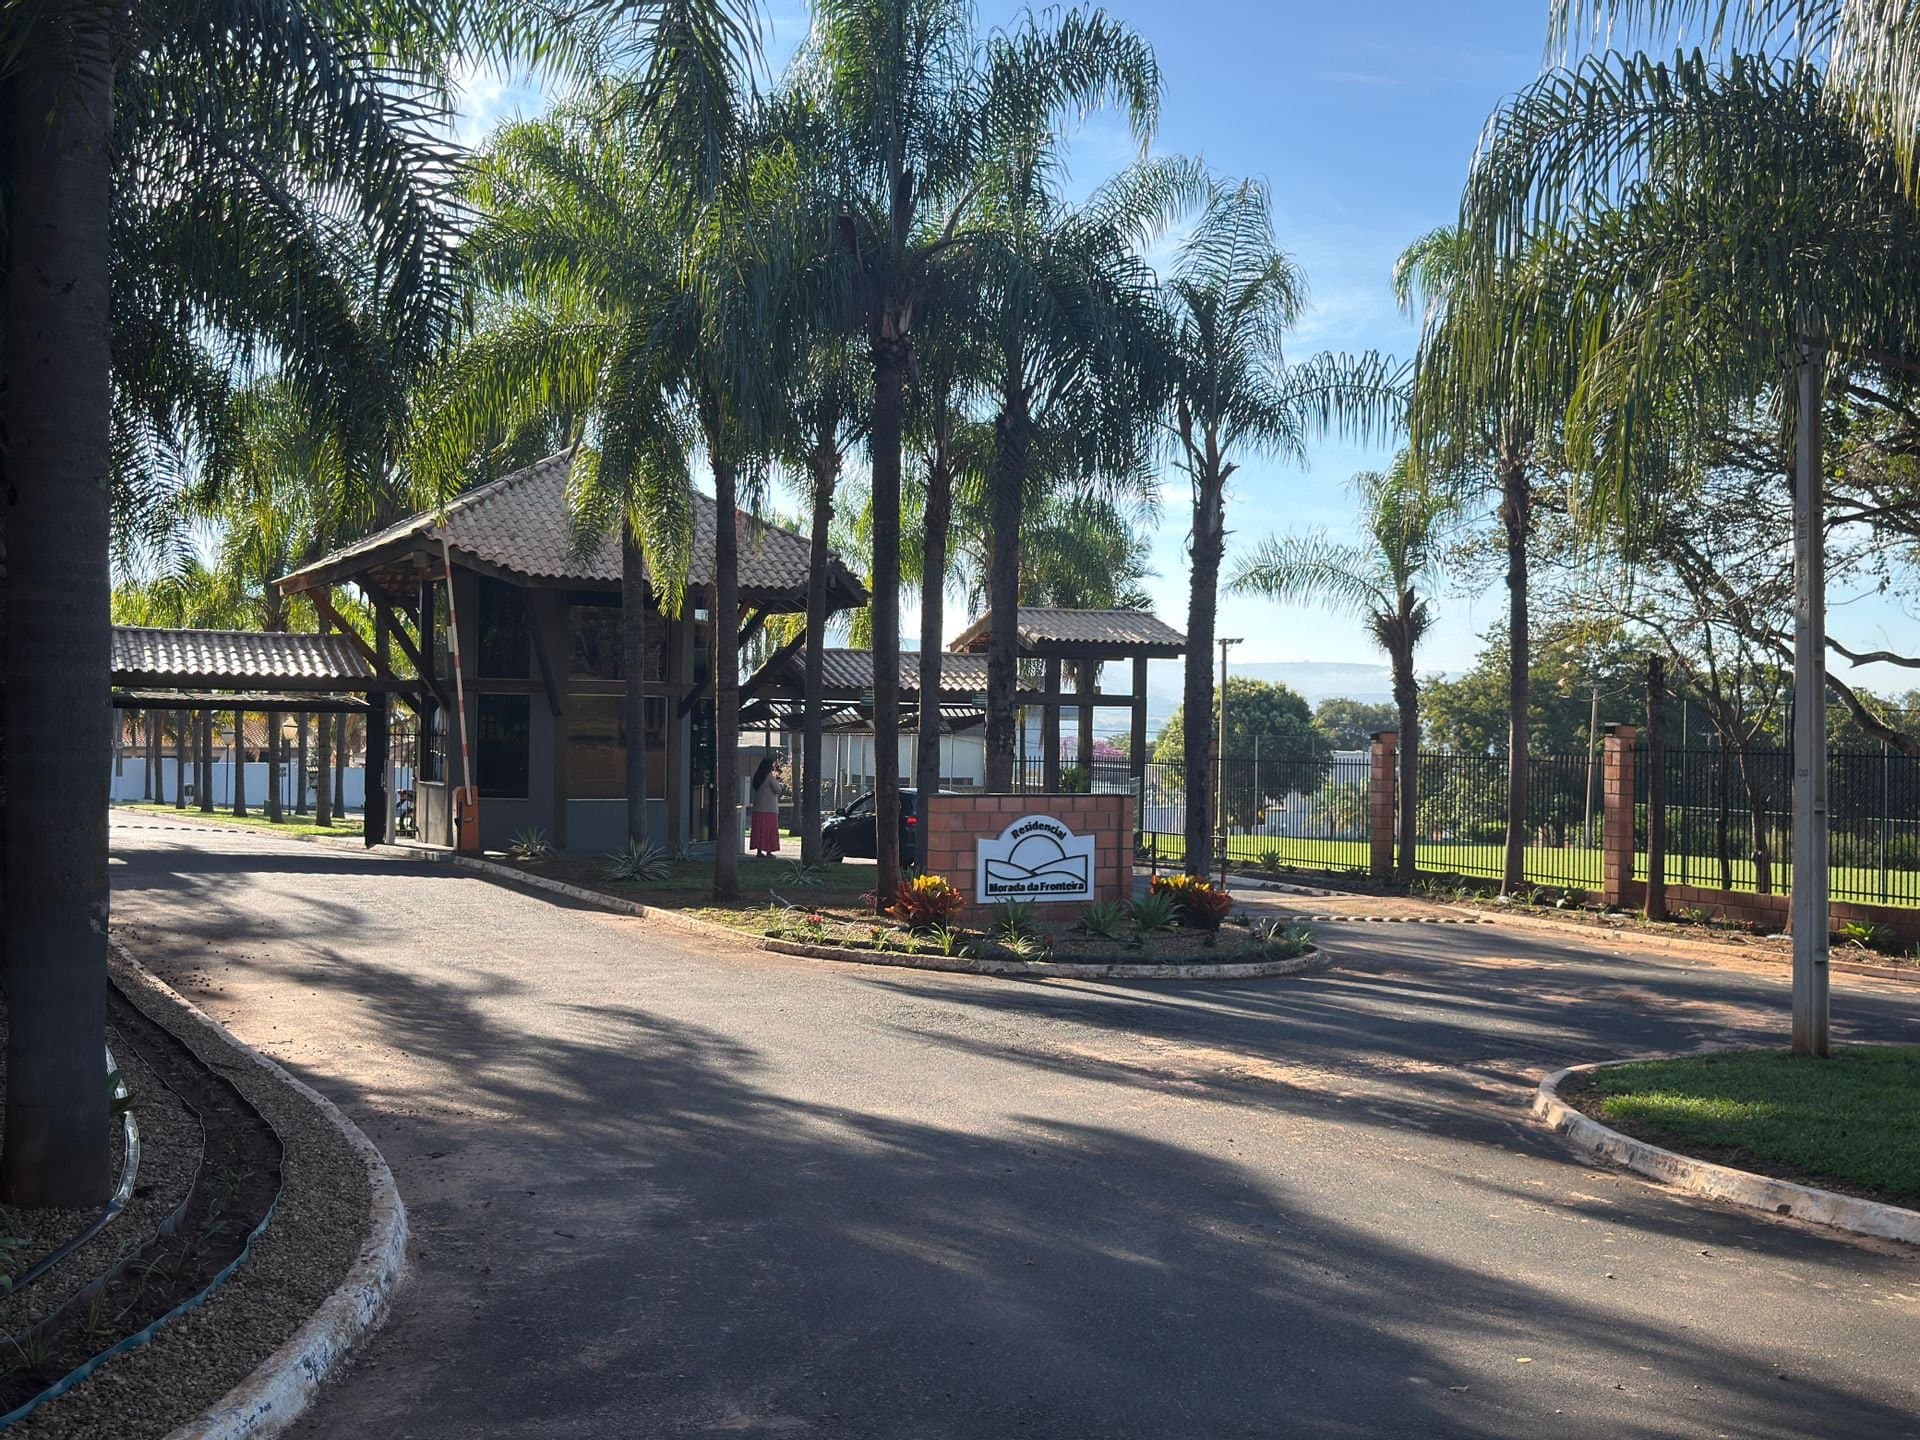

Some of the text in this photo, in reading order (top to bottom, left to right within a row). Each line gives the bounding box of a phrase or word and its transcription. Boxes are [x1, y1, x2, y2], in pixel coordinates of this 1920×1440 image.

[1011, 821, 1067, 840] Residencial
[989, 881, 1084, 892] Morada da Fronteira
